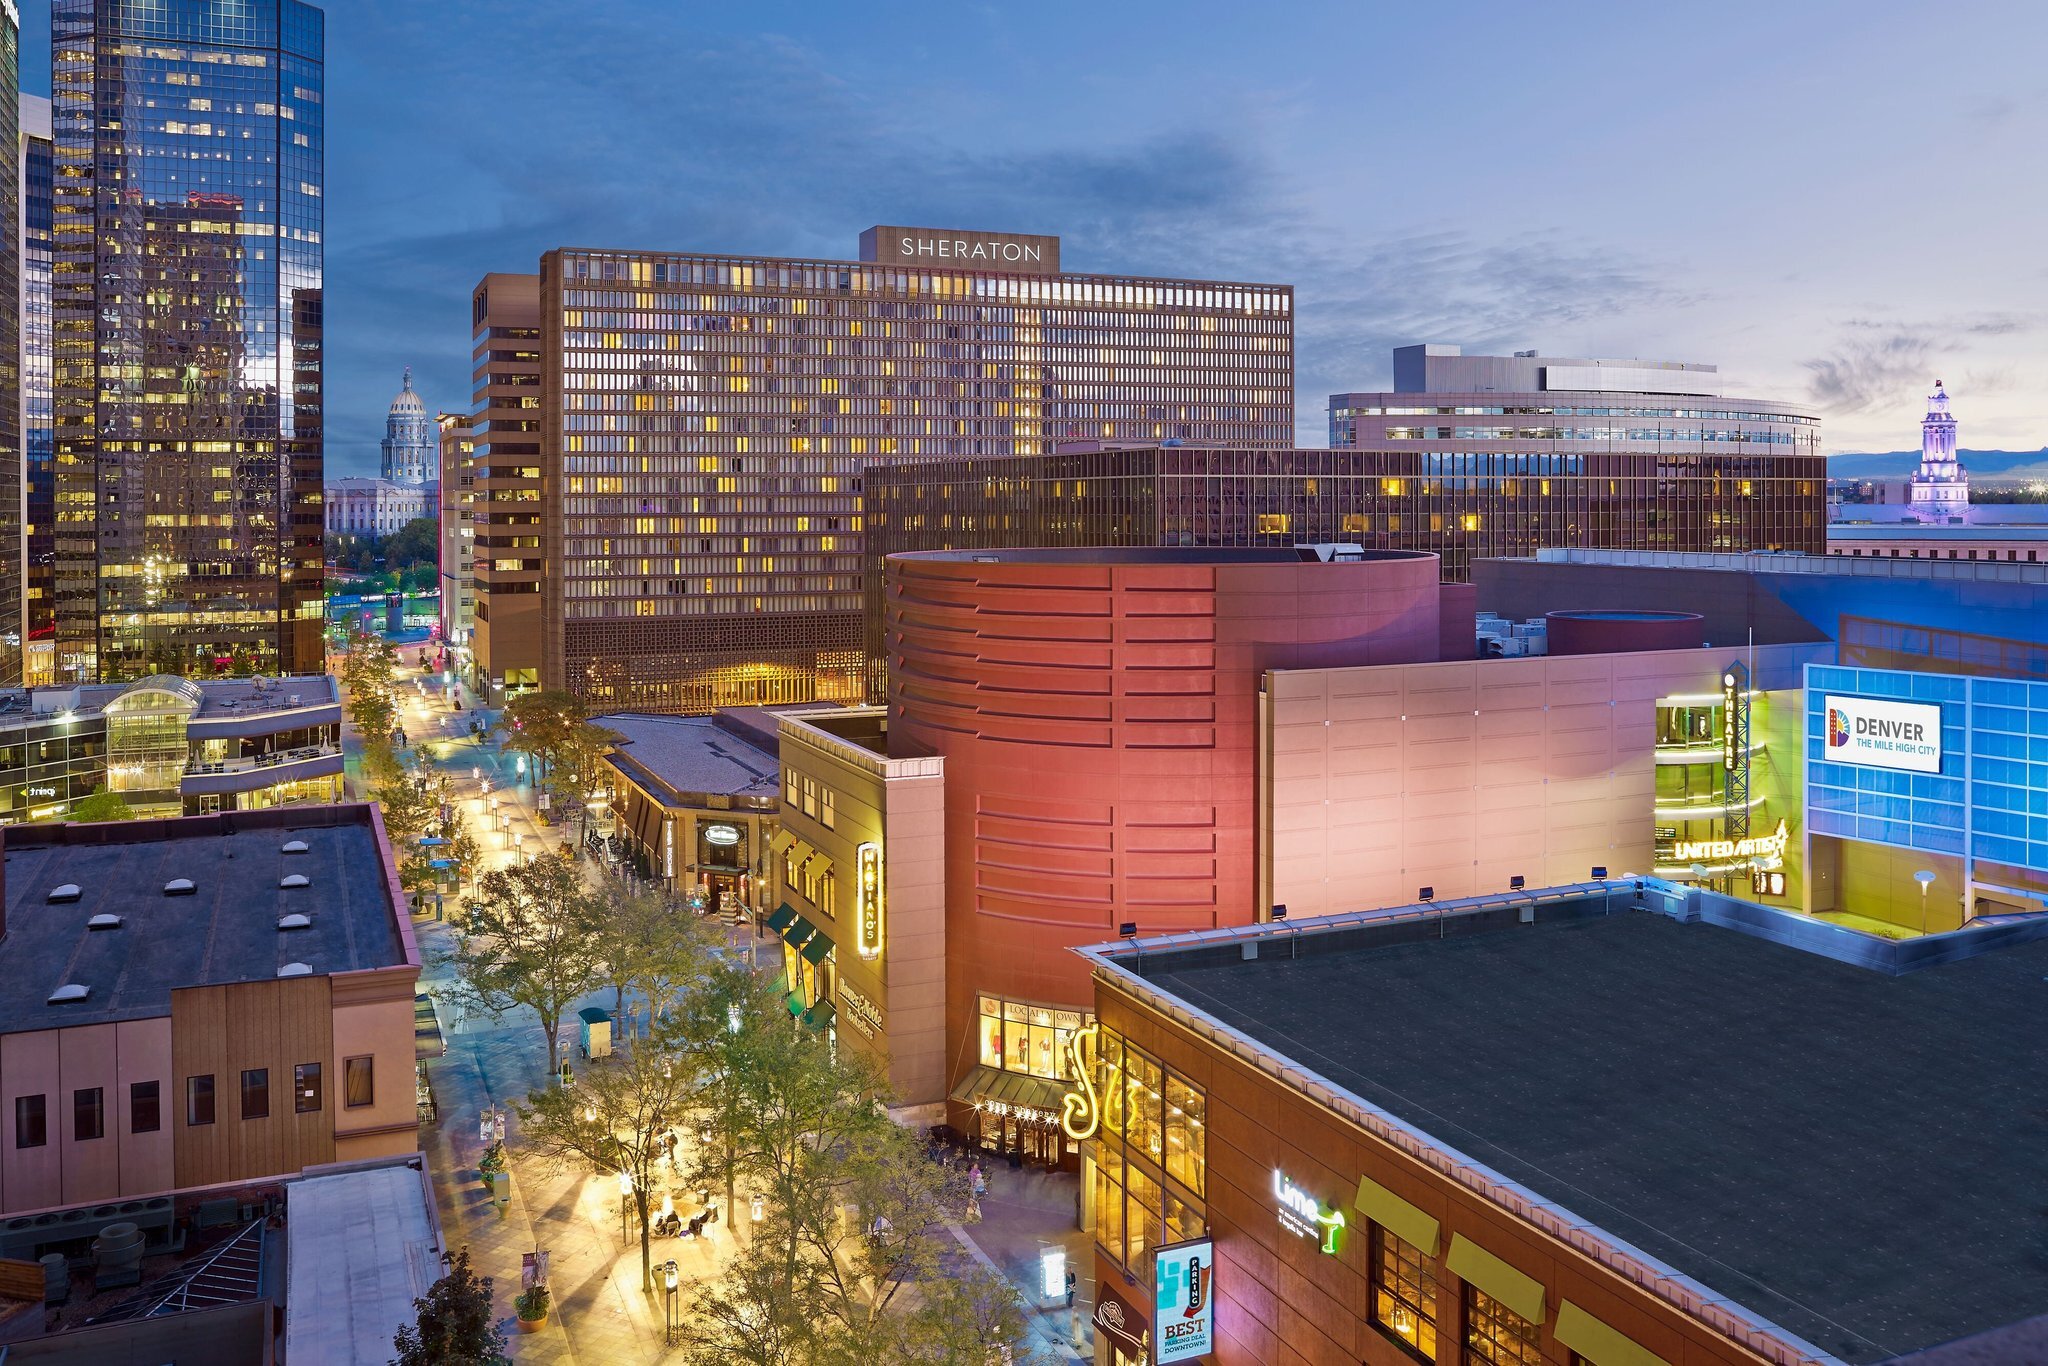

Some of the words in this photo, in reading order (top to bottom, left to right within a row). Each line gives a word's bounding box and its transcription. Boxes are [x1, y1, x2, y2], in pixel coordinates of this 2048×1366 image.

[901, 237, 1040, 262] SHERATON
[1725, 688, 1734, 769] THEATRE
[1856, 716, 1924, 741] DENVER
[1856, 737, 1872, 748] THE
[1874, 740, 1893, 751] MILE
[1895, 743, 1916, 754] HIGH
[1918, 745, 1937, 756] CITY
[1675, 840, 1734, 860] UNITED
[1009, 1004, 1053, 1019] LOCALLY
[1164, 1318, 1205, 1340] BEST
[1164, 1336, 1190, 1347] PARKING
[1190, 1333, 1206, 1343] DEAL
[1164, 1340, 1207, 1354] DOWNTOWN!
